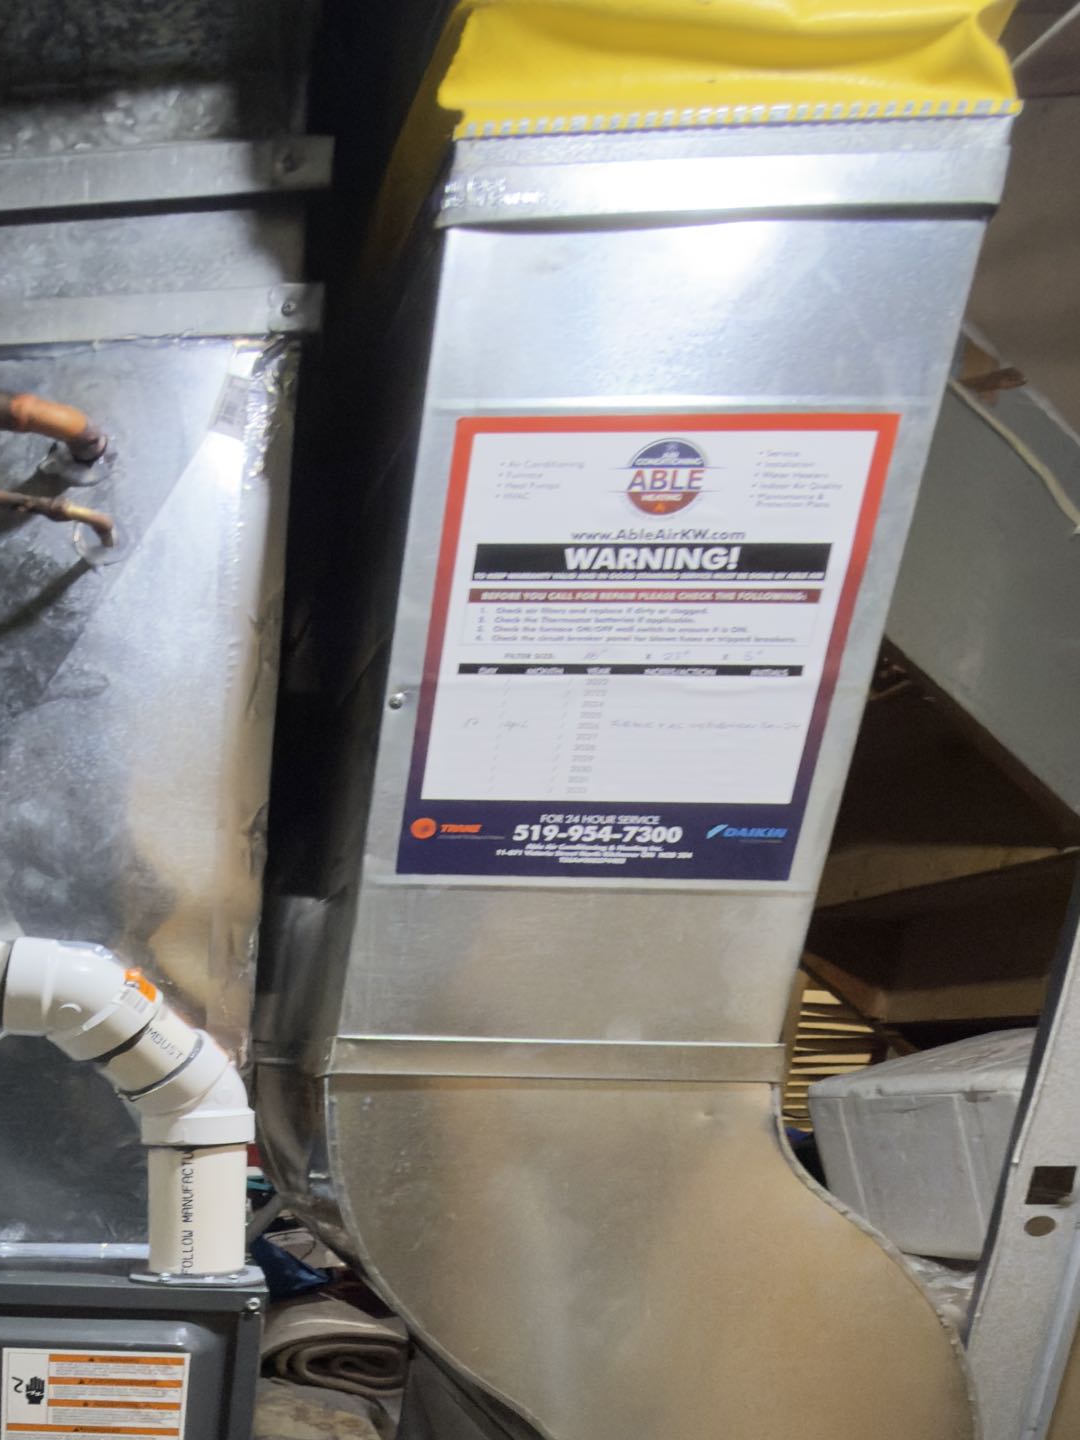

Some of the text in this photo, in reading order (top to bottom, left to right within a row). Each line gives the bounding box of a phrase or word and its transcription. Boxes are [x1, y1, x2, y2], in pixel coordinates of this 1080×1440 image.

[627, 469, 705, 490] ABLE
[571, 528, 746, 541] www.AbleAirKW.com
[564, 546, 742, 570] WARNING!
[481, 591, 808, 601] BEFORE YOU CALL FOR REPAIR PLEASE CHECK THE FOLLOWING:
[540, 814, 662, 824] FOR 24 HOUR SERVICE
[512, 824, 684, 842] 519-954-7300
[723, 827, 788, 838] DAIKIN
[181, 1229, 195, 1278] FOLLOW
